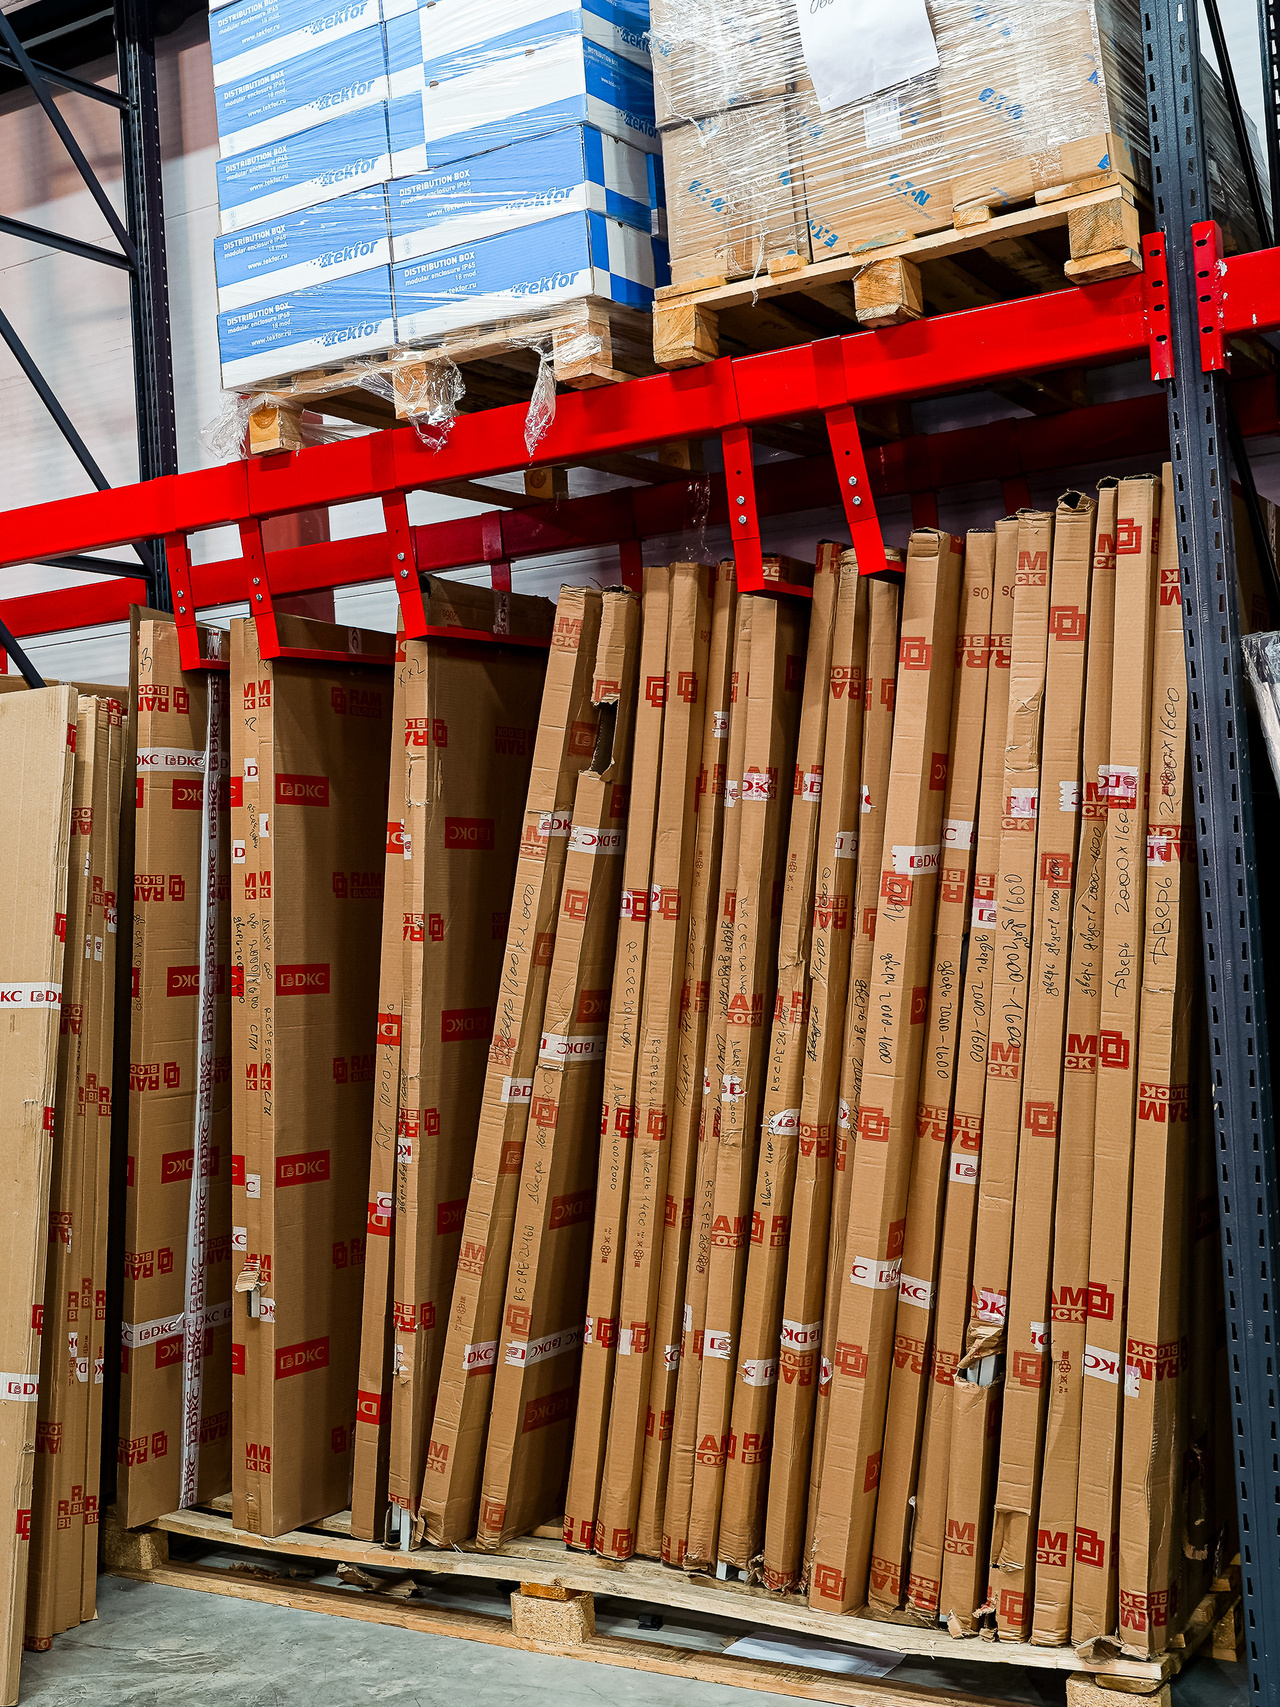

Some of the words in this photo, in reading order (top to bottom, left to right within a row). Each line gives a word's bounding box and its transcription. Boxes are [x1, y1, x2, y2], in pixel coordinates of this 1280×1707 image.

[218, 3, 263, 27] DISTRIBUTION
[315, 2, 368, 32] tekfor
[224, 77, 270, 99] DISTRIBUTION
[271, 70, 285, 84] BOX
[322, 79, 375, 109] tekfor
[225, 151, 272, 173] DISTRIBUTION
[273, 145, 287, 158] BOX
[326, 157, 378, 186] tekfor
[399, 174, 452, 196] DISTRIBUTION
[454, 169, 470, 181] BOX
[223, 230, 270, 251] DISTRIBUTION
[272, 225, 286, 236] BOX
[248, 252, 288, 270] www.tekfor.ru
[325, 240, 378, 267] tekfor
[404, 256, 457, 278] DISTRIBUTION
[459, 251, 475, 263] BOX
[405, 274, 430, 286] modular
[431, 266, 460, 280] enclosure
[461, 261, 476, 271] IP65
[523, 271, 579, 296] tekfor
[227, 307, 273, 326] DISTRIBUTION
[275, 302, 289, 313] BOX
[328, 320, 382, 345] tekfor
[176, 754, 205, 767] DKC
[294, 783, 325, 798] DKC
[449, 826, 480, 841] DKC
[294, 972, 325, 987] DKC
[295, 1159, 326, 1177] DKC
[150, 1322, 177, 1338] DKC
[294, 1345, 325, 1366] DKC
[468, 1347, 494, 1364] DKC
